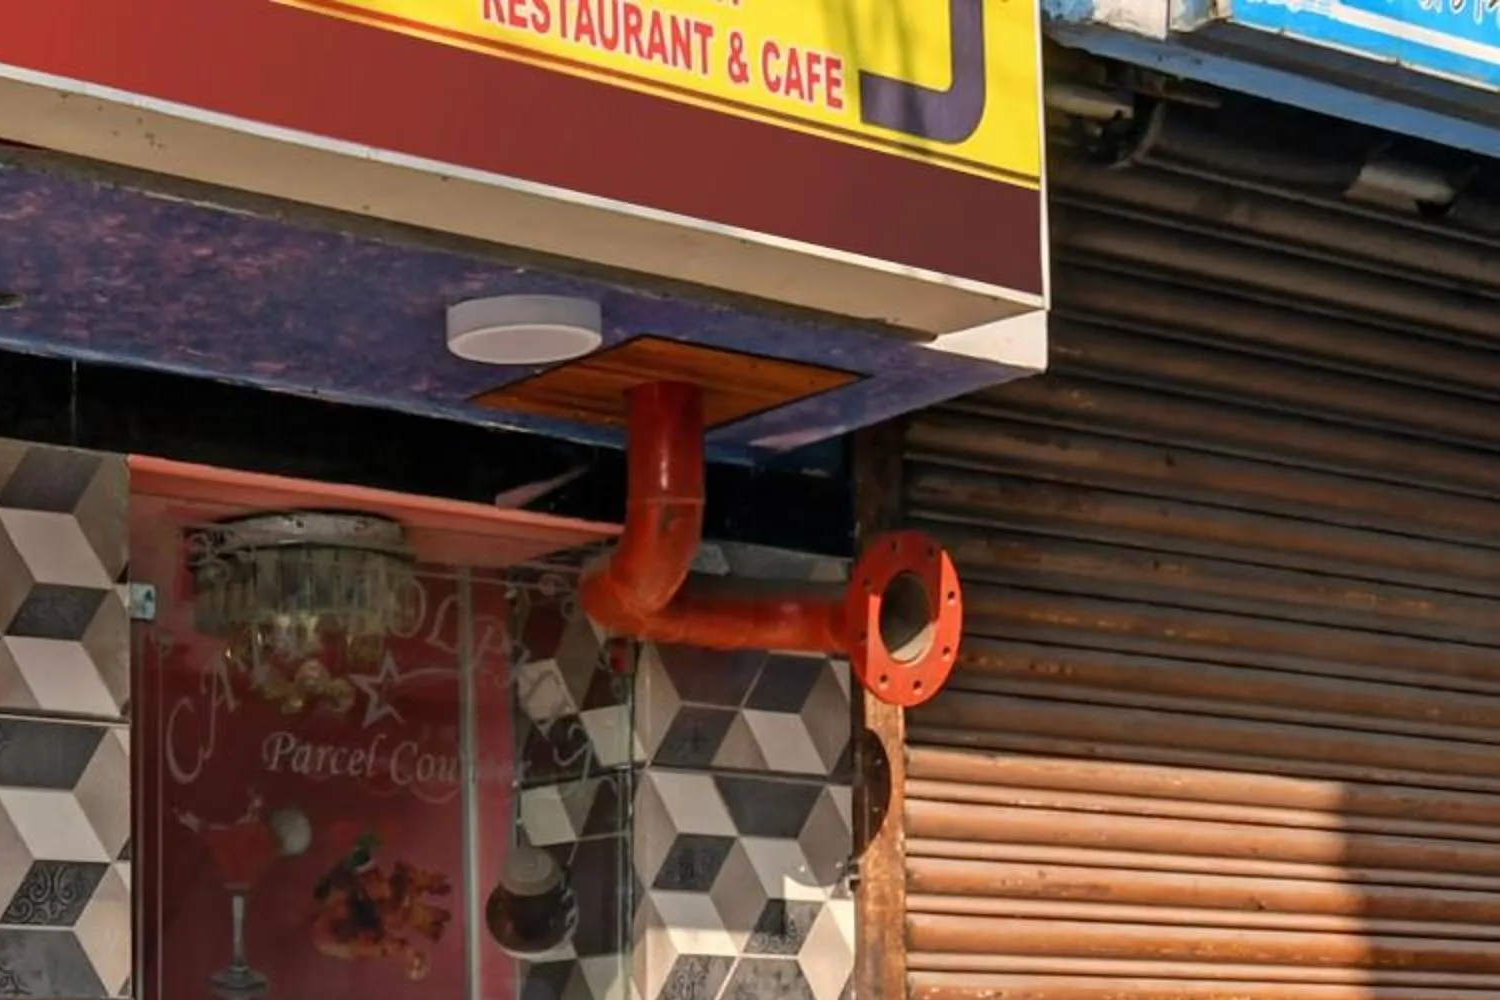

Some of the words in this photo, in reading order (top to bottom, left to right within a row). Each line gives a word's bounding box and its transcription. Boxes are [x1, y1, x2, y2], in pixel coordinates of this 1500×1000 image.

[726, 31, 750, 85] &
[761, 41, 843, 109] CAFE
[262, 731, 387, 778] Parcel
